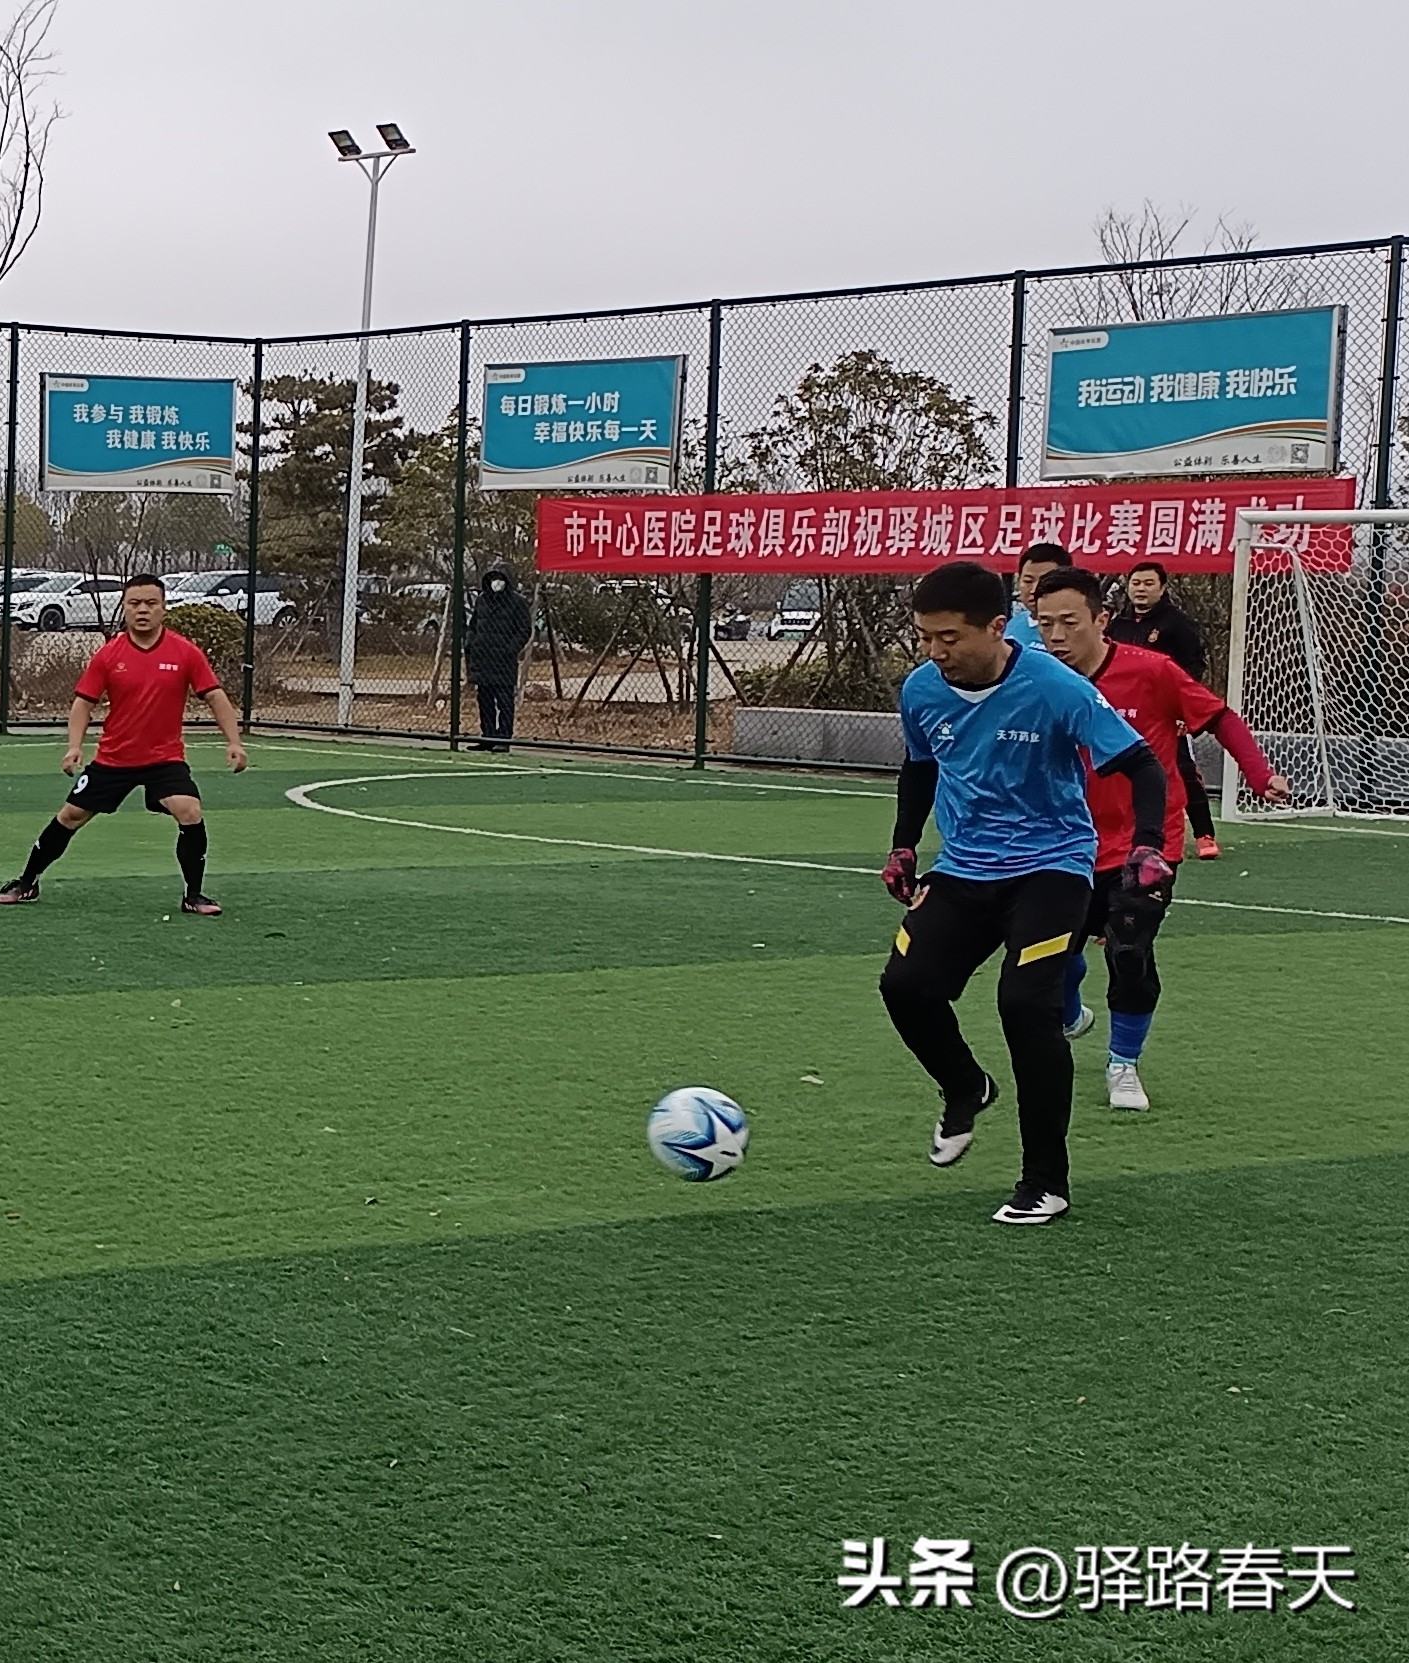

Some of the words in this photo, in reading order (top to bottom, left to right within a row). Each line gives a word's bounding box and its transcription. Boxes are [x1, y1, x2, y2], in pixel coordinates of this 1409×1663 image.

[1077, 376, 1144, 408] 我运动
[1150, 371, 1221, 403] 我健康
[1225, 365, 1297, 399] 我快乐
[73, 403, 124, 424] 我参与
[129, 405, 180, 426] 我锻炼
[500, 391, 621, 416] 每日锻炼一小时
[106, 429, 157, 450] 我健康
[161, 430, 211, 451] 我快乐
[533, 419, 657, 443] 幸福快乐每一天
[73, 774, 89, 795] 9
